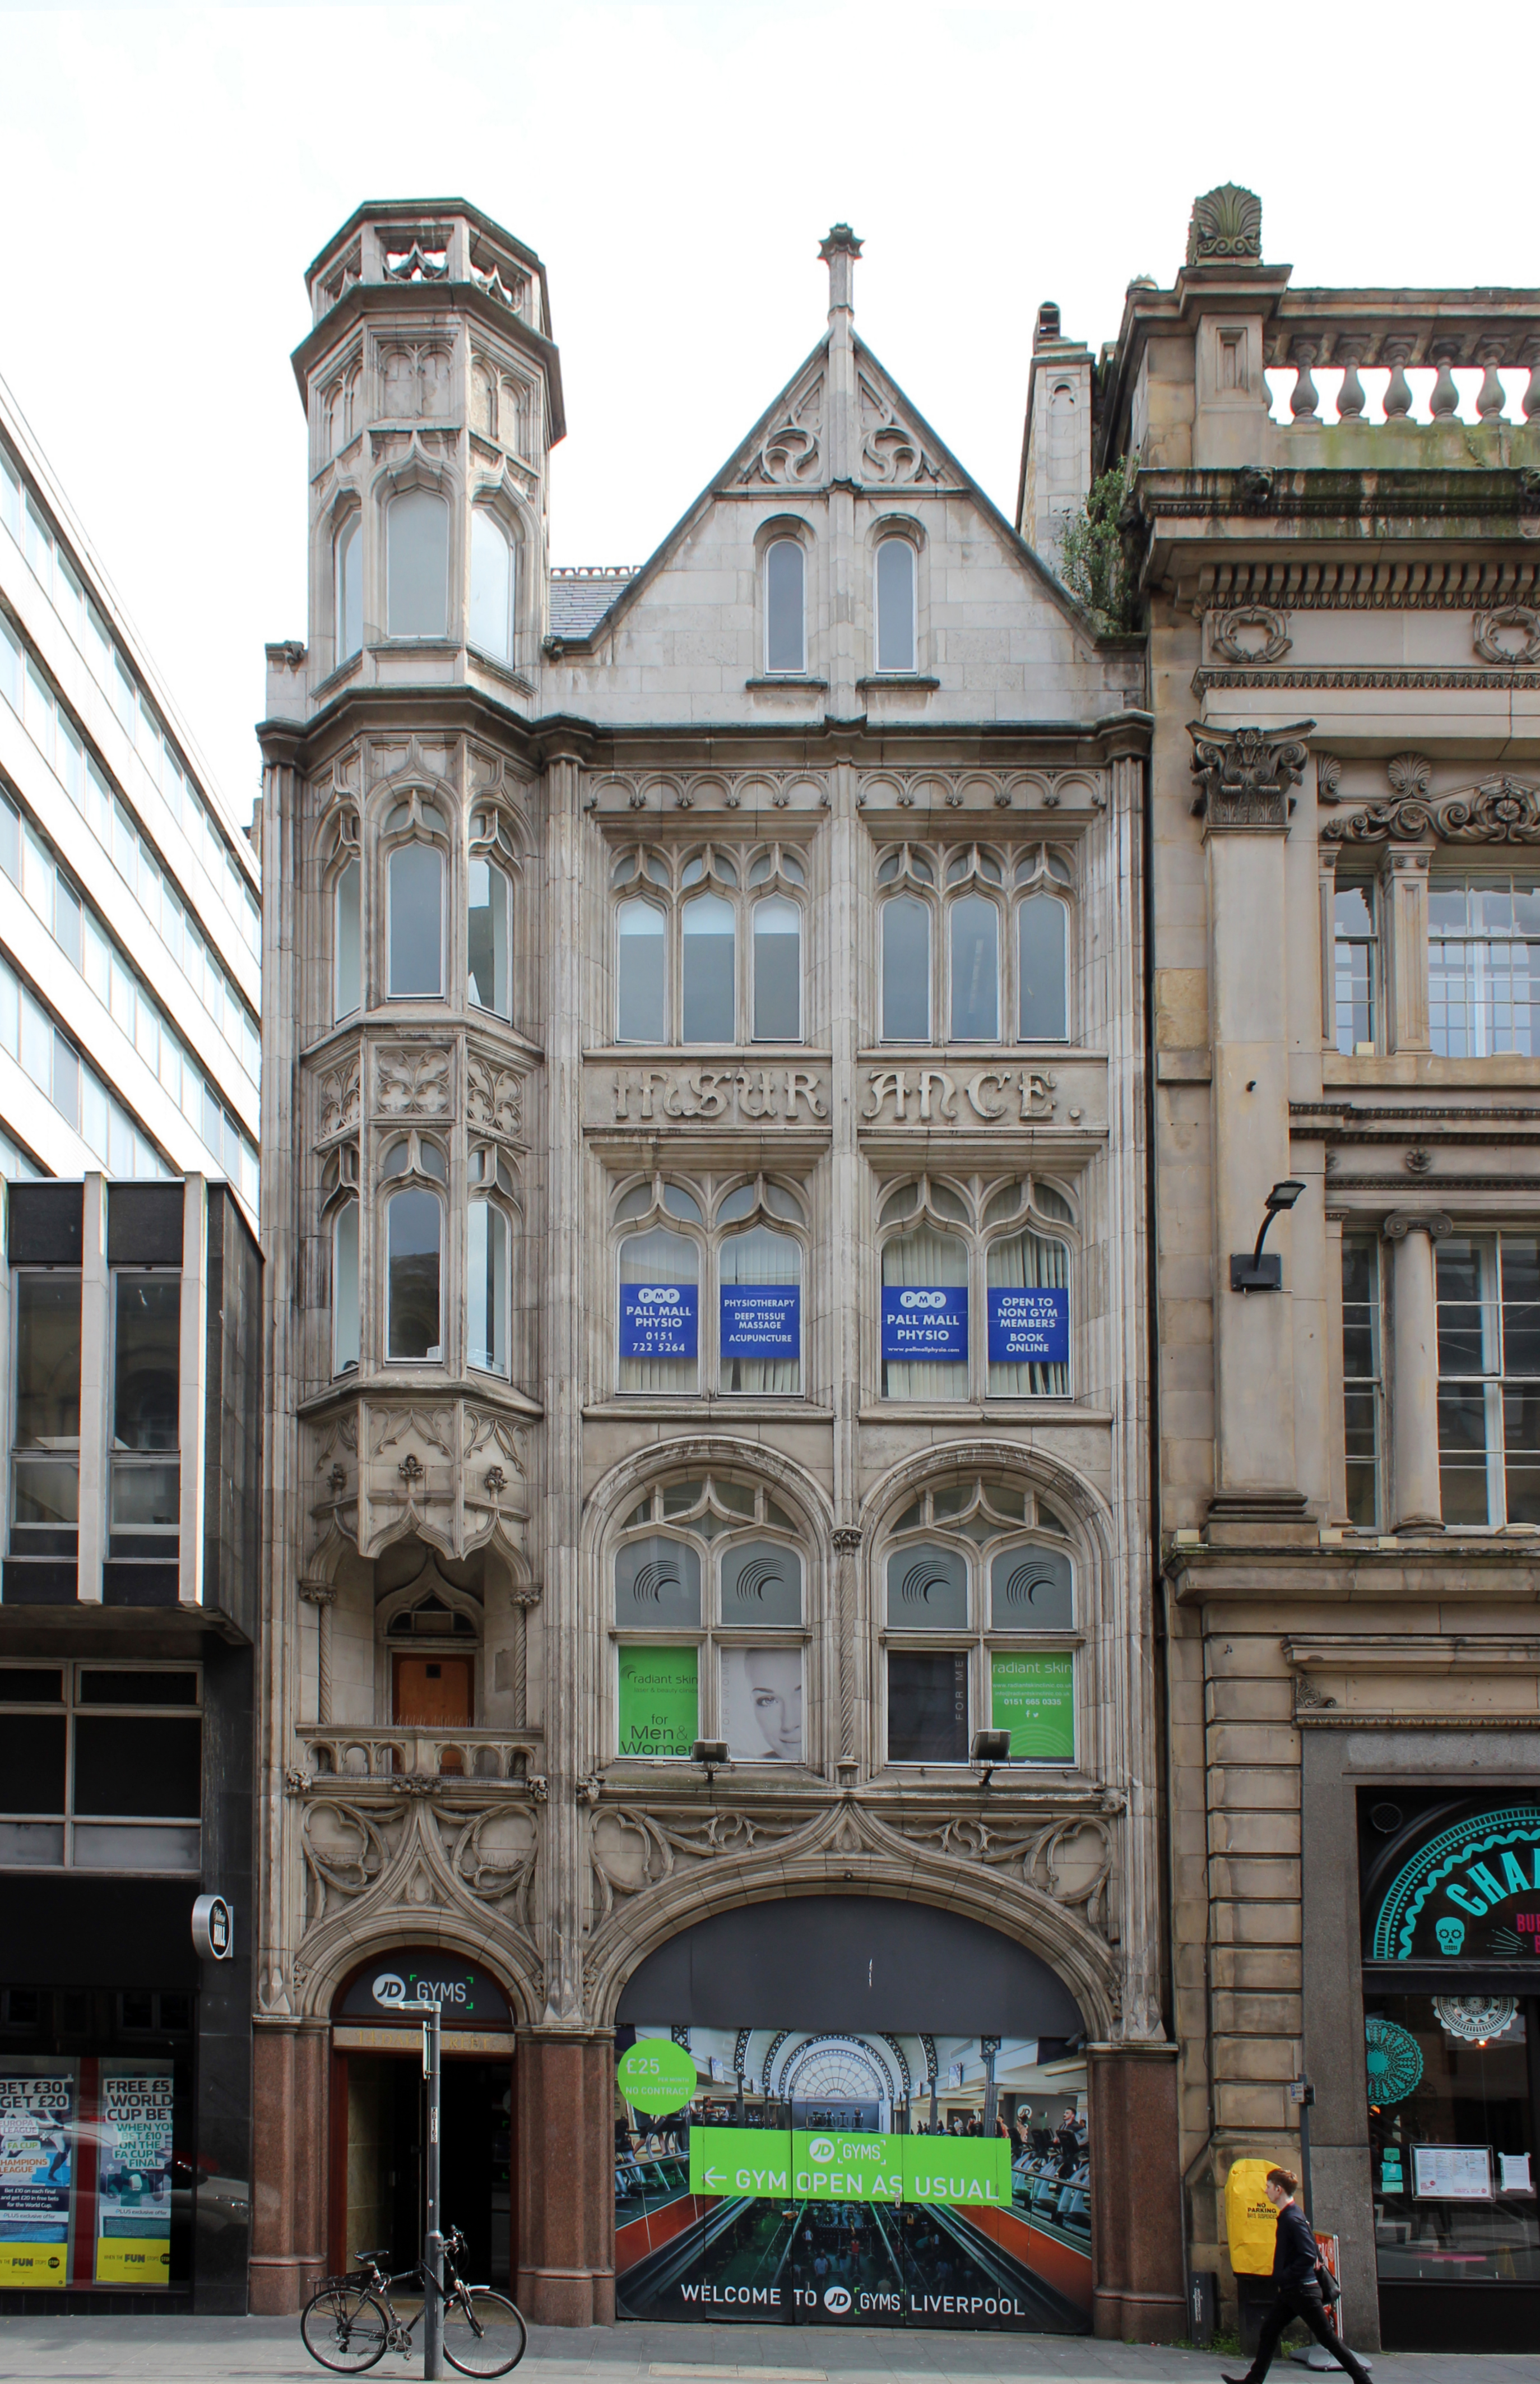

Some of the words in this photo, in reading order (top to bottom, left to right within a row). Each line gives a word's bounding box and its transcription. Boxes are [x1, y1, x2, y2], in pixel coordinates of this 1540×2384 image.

[1002, 1298, 1035, 1307] OPEN
[1037, 1298, 1054, 1307] TO
[626, 1306, 655, 1316] PALL
[658, 1307, 692, 1316] MALL
[998, 1308, 1027, 1317] NON
[1030, 1308, 1058, 1317] GYM
[636, 1318, 683, 1327] PHYSIO
[887, 1314, 919, 1325] PALL
[923, 1315, 959, 1325] MALL
[1000, 1319, 1056, 1328] MEMBERS
[646, 1331, 672, 1340] 0151
[897, 1330, 949, 1341] PHYSIO
[1010, 1333, 1044, 1342] BOOK
[633, 1343, 653, 1351] 722
[658, 1343, 685, 1352] 5264
[1006, 1343, 1049, 1352] ONLINE
[992, 1661, 1041, 1673] radiant
[1045, 1662, 1073, 1673] skin
[634, 1674, 672, 1684] radiant
[675, 1675, 698, 1684] skin
[955, 1691, 963, 1720] FOR
[652, 1714, 668, 1725] for
[631, 1725, 674, 1739] Men
[676, 1725, 689, 1740] &
[214, 1923, 226, 1947] HILL
[377, 1981, 402, 1998] JD
[416, 1981, 466, 2003] GYMS
[359, 2030, 376, 2045] 14
[440, 2035, 491, 2049] TREET
[626, 2058, 660, 2075] £25
[33, 2081, 63, 2094] £30
[106, 2080, 148, 2093] FREE
[151, 2080, 170, 2093] £5
[625, 2086, 639, 2095] NO
[641, 2086, 690, 2095] CONTRACT
[0, 2096, 34, 2108] GET
[38, 2095, 67, 2108] £20
[110, 2094, 173, 2107] WORLD
[107, 2108, 142, 2121] CUP
[117, 2123, 151, 2131] WHEN
[122, 2132, 143, 2140] BET
[119, 2141, 136, 2149] ON
[138, 2141, 161, 2149] THE
[130, 2150, 153, 2158] CUP
[814, 2144, 832, 2156] JD
[843, 2144, 881, 2160] GYMS
[129, 2159, 161, 2167] FINAL
[735, 2169, 786, 2191] GYM
[796, 2172, 863, 2195] OPEN
[871, 2175, 903, 2196] AS
[915, 2176, 1000, 2200] USUAL
[12, 2258, 34, 2266] FUN
[124, 2253, 146, 2263] FUN
[681, 2284, 782, 2306] WELCOME
[793, 2289, 817, 2307] TO
[828, 2293, 847, 2307] JD
[860, 2292, 901, 2311] GYMS
[911, 2294, 1026, 2316] LIVERPOOL
